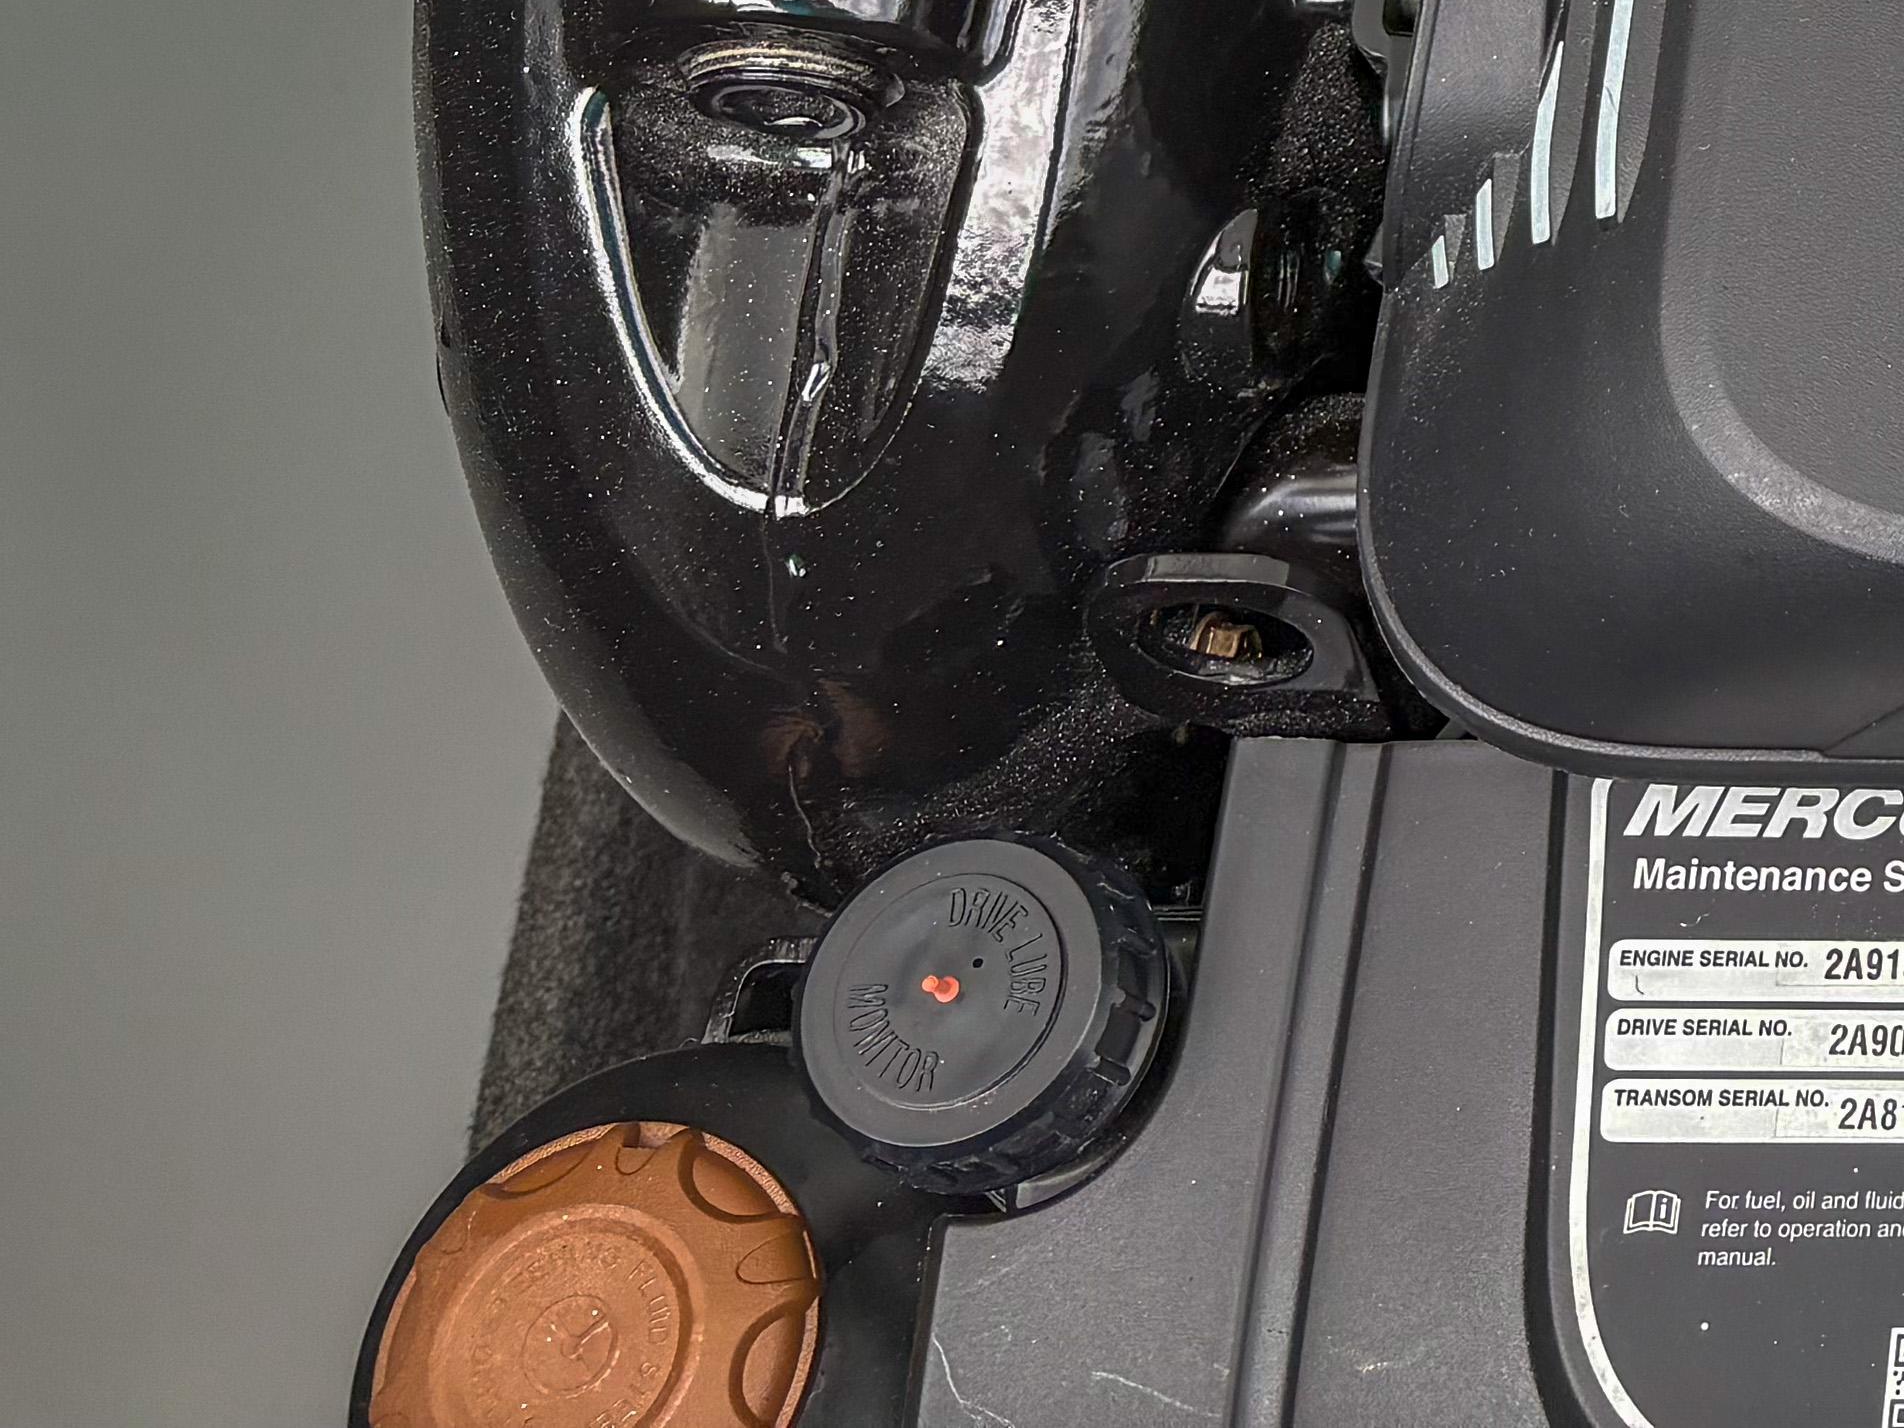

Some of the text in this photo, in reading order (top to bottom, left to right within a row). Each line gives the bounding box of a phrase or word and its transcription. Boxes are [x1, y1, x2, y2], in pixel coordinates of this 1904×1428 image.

[1633, 857, 1872, 893] Maintenance
[948, 887, 1047, 1016] DRIVE LUBE
[1619, 949, 1695, 967] ENGINE
[1699, 950, 1770, 968] SERIAL
[1774, 950, 1808, 968] NO.
[847, 983, 939, 1093] MONITOR
[1616, 1018, 1678, 1036] DRIVE
[1682, 1018, 1753, 1036] SERIAL
[1758, 1019, 1792, 1037] NO.
[1614, 1088, 1713, 1107] TRANSOM
[1718, 1088, 1790, 1107] SERIAL
[1795, 1089, 1829, 1108] NO.
[1705, 1190, 1740, 1210] For
[1745, 1190, 1786, 1212] fuel,
[1792, 1190, 1816, 1210] oil
[1821, 1191, 1859, 1210] and
[1701, 1218, 1749, 1238] refer
[1753, 1219, 1772, 1238] to
[1777, 1218, 1871, 1243] operation
[1697, 1247, 1776, 1267] manual.
